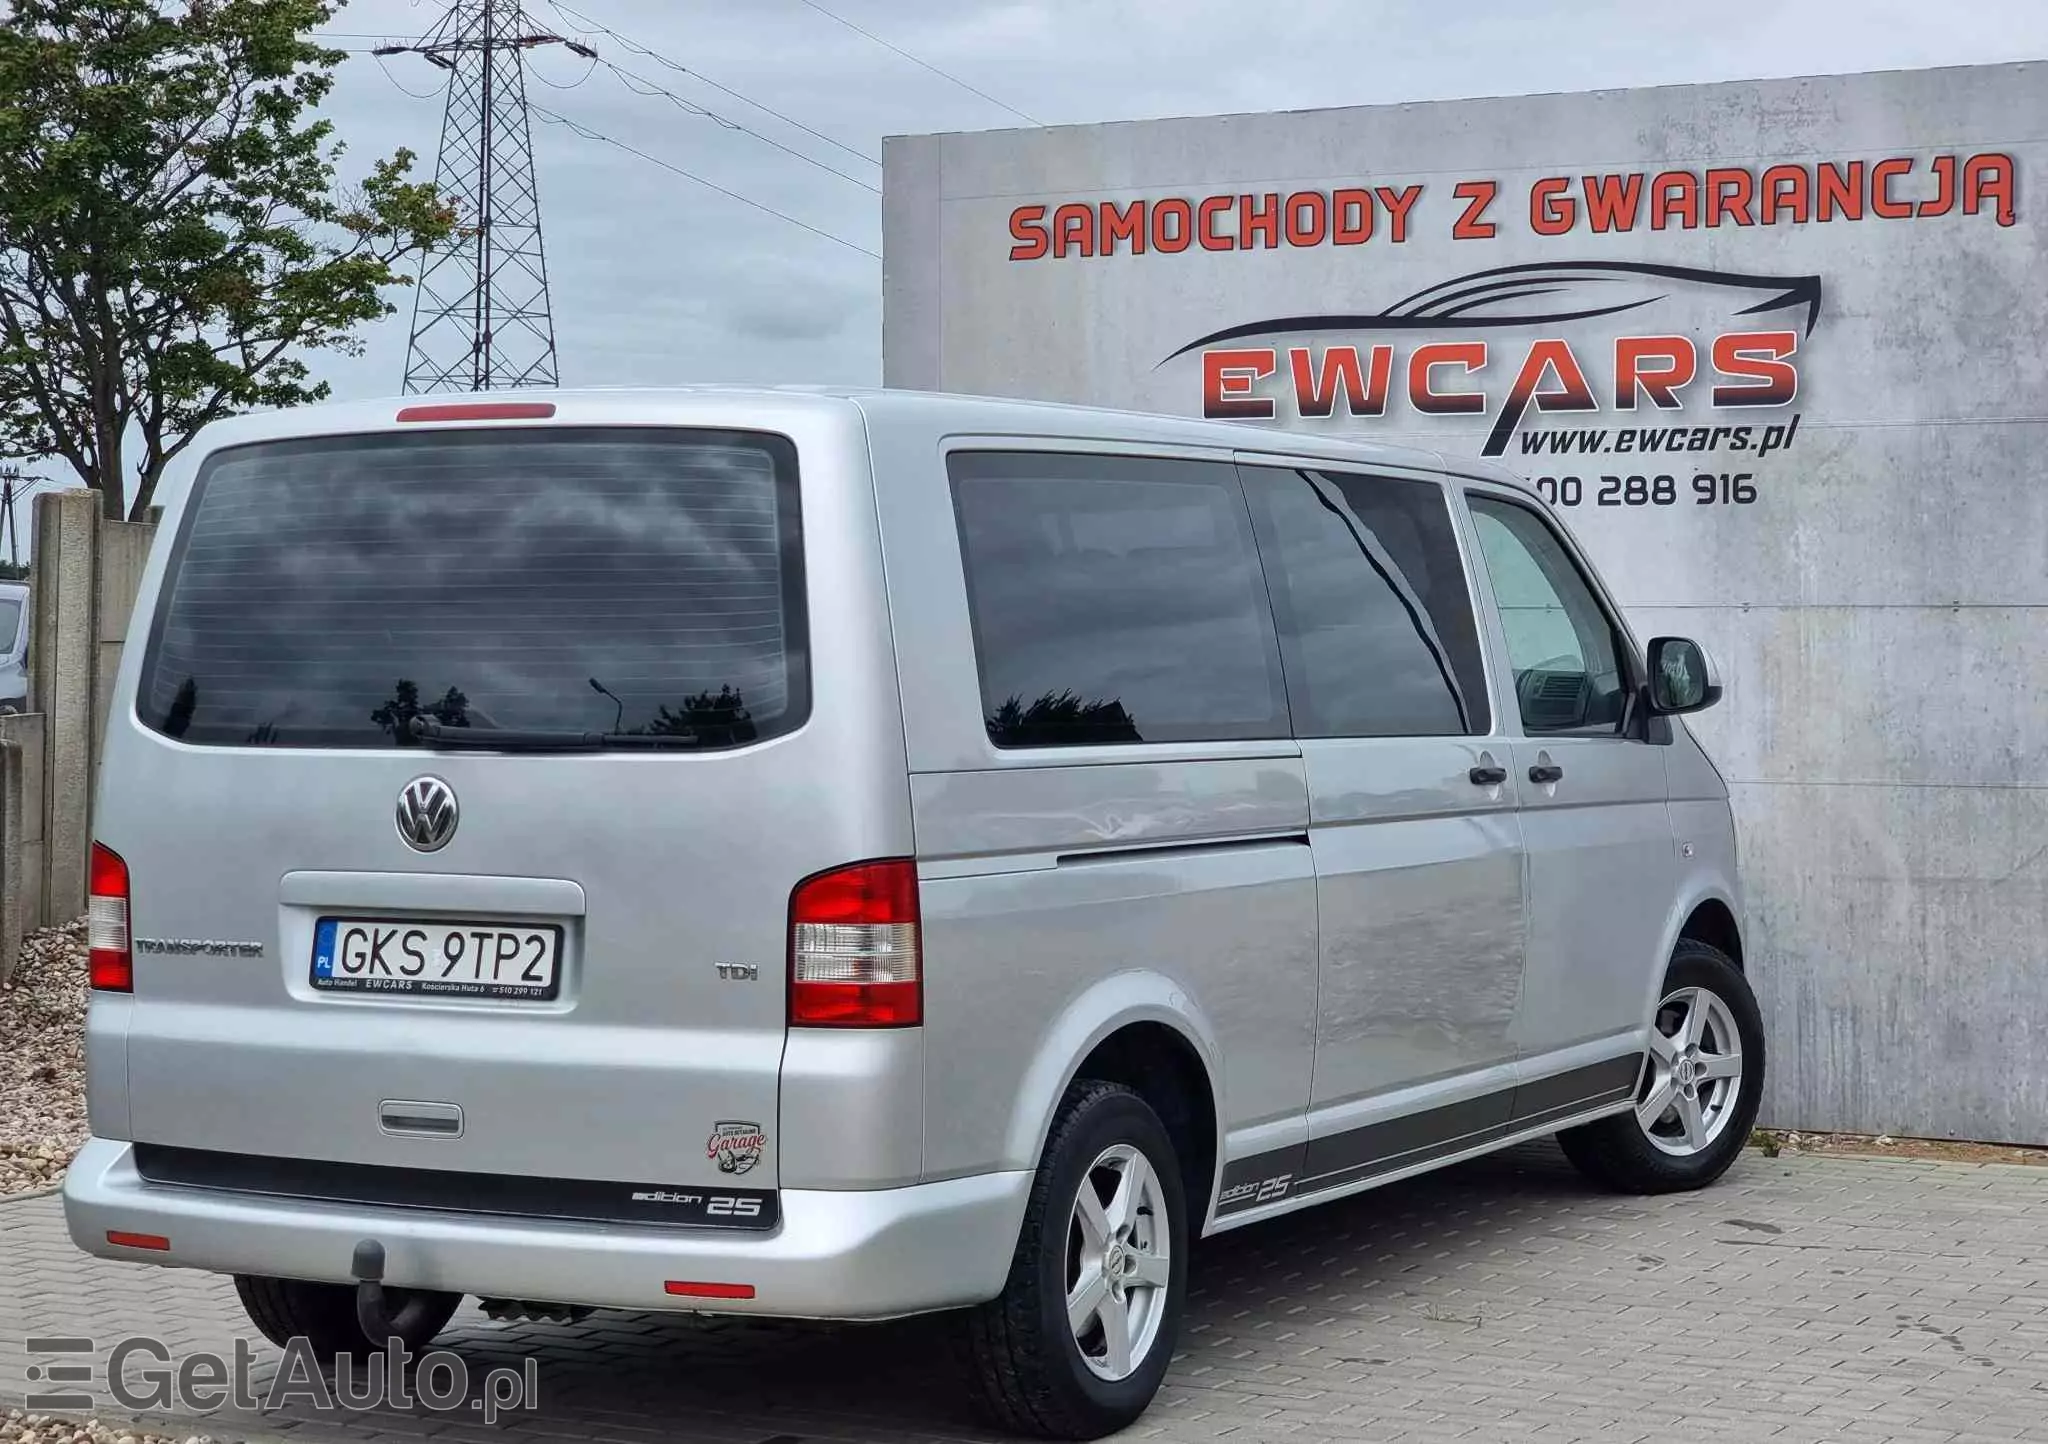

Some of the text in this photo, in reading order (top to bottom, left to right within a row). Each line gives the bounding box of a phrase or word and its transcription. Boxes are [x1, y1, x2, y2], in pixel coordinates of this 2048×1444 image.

[1009, 153, 2017, 261] SAMOCHODY Z GWARANCJĄ
[1202, 331, 1799, 458] EWCARS
[1520, 413, 1801, 458] www.ewcars.pl
[1525, 472, 1758, 507] 00 288 916
[134, 937, 264, 959] TRANSPORTER
[317, 956, 331, 970] PL
[341, 926, 546, 982] GKS 9TP2
[365, 979, 413, 991] EWCARS
[707, 1132, 767, 1160] Garage
[706, 1196, 763, 1217] 25
